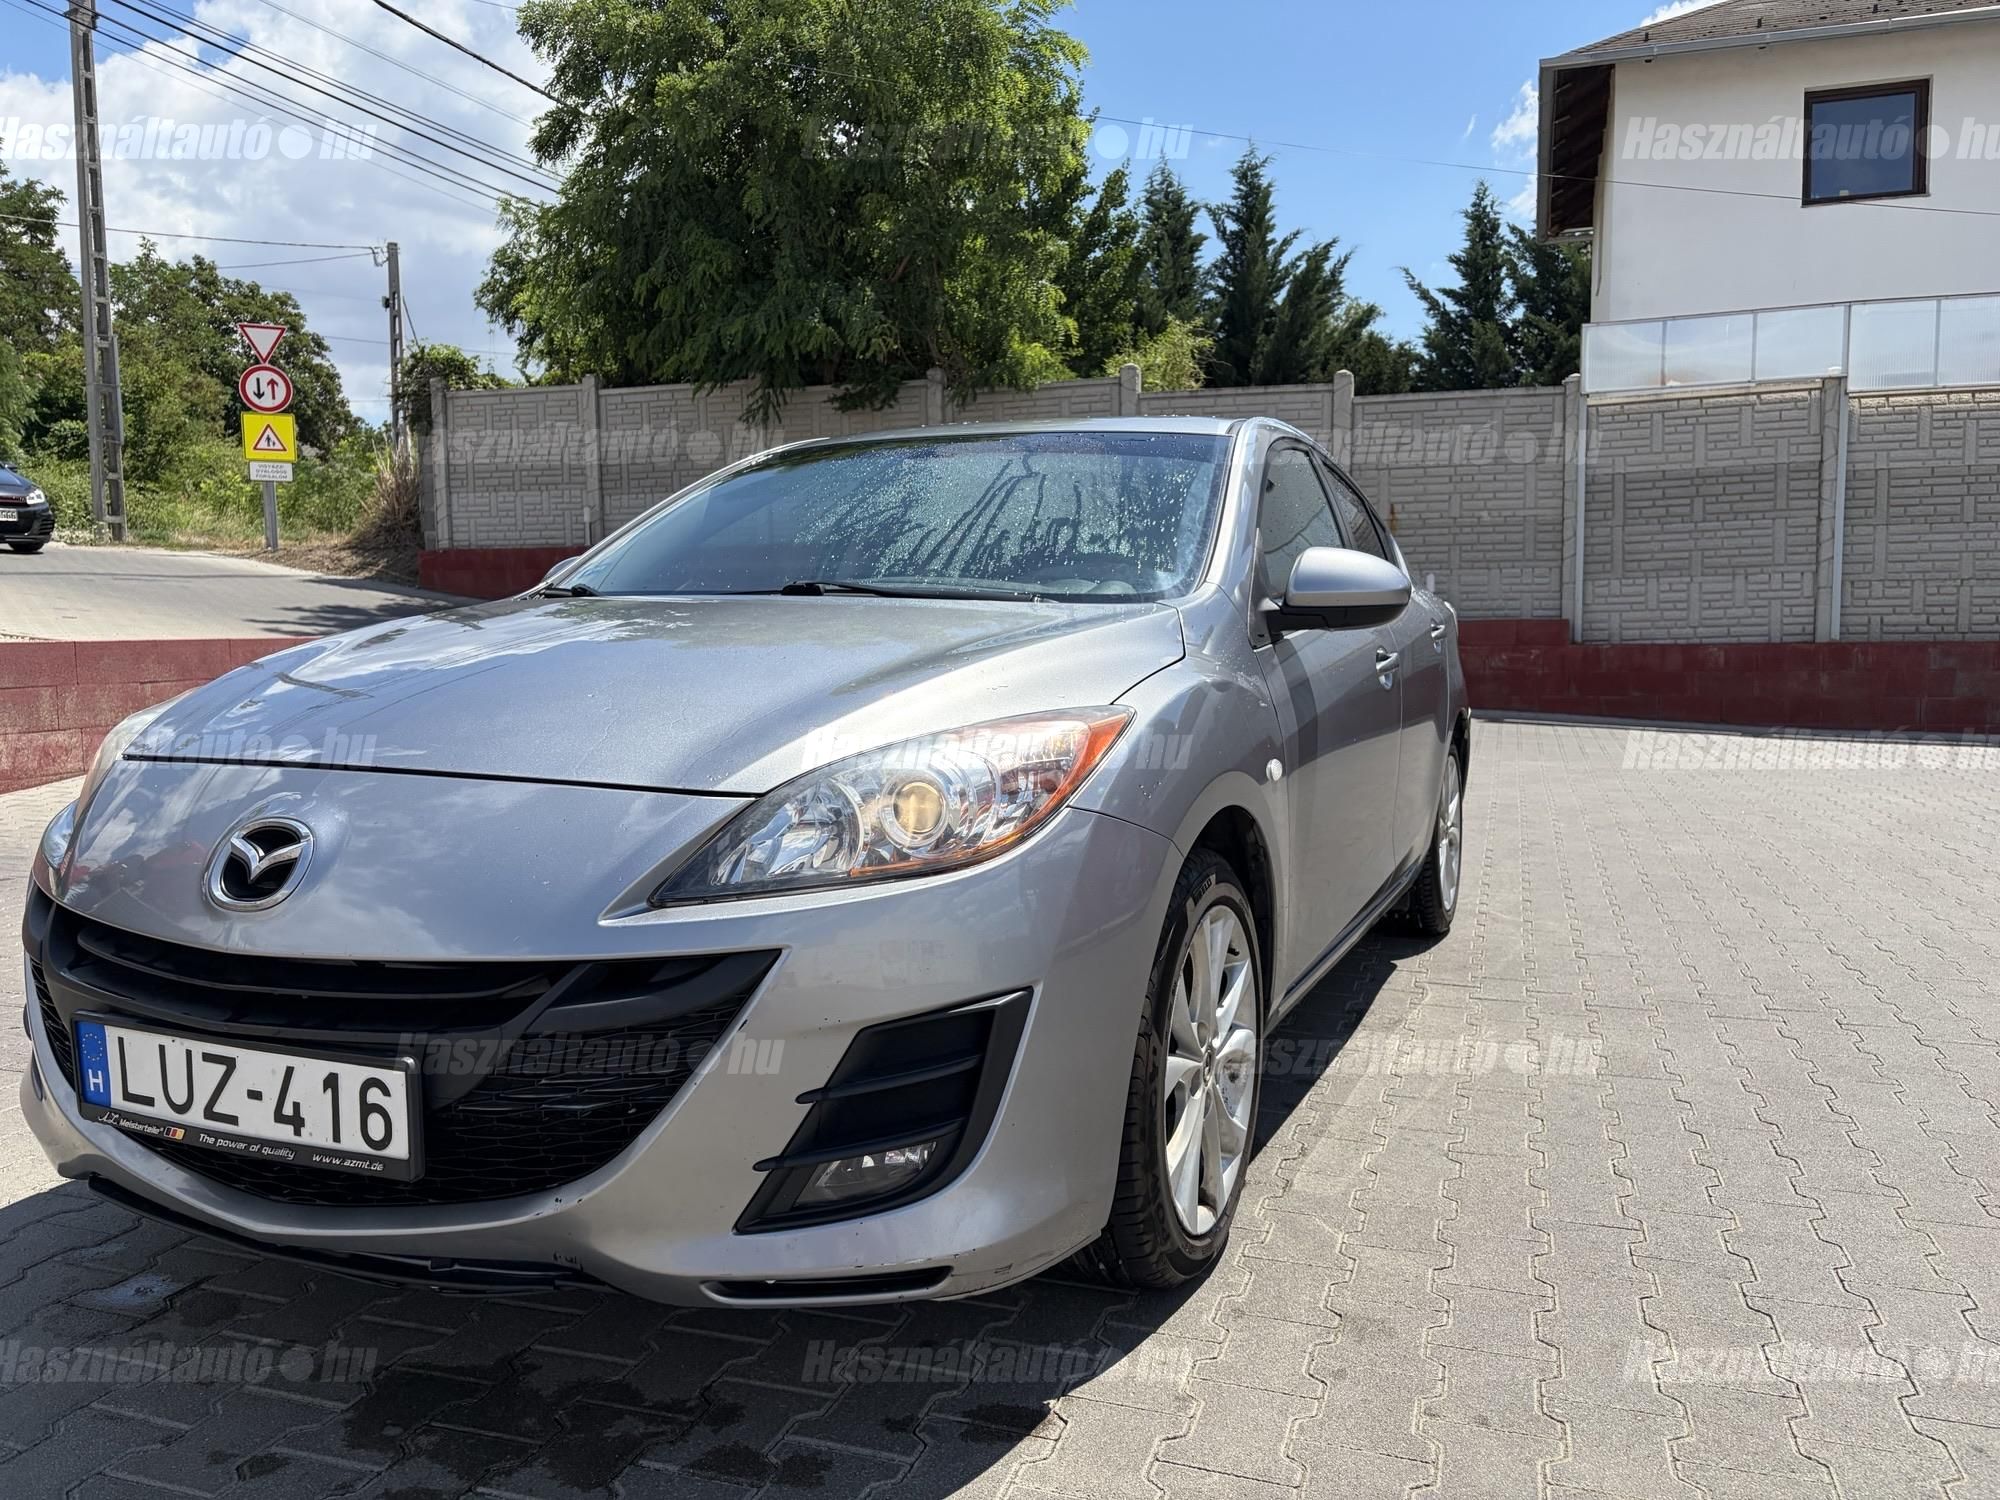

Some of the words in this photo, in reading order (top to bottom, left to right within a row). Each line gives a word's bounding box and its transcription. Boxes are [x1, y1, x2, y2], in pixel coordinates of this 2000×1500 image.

[87, 1069, 104, 1093] H
[117, 1036, 393, 1152] LUZ-416
[199, 1133, 215, 1145] The
[216, 1138, 248, 1151] power
[249, 1143, 261, 1152] of
[262, 1146, 296, 1161] quality
[312, 1152, 384, 1171] www.azmt.de
